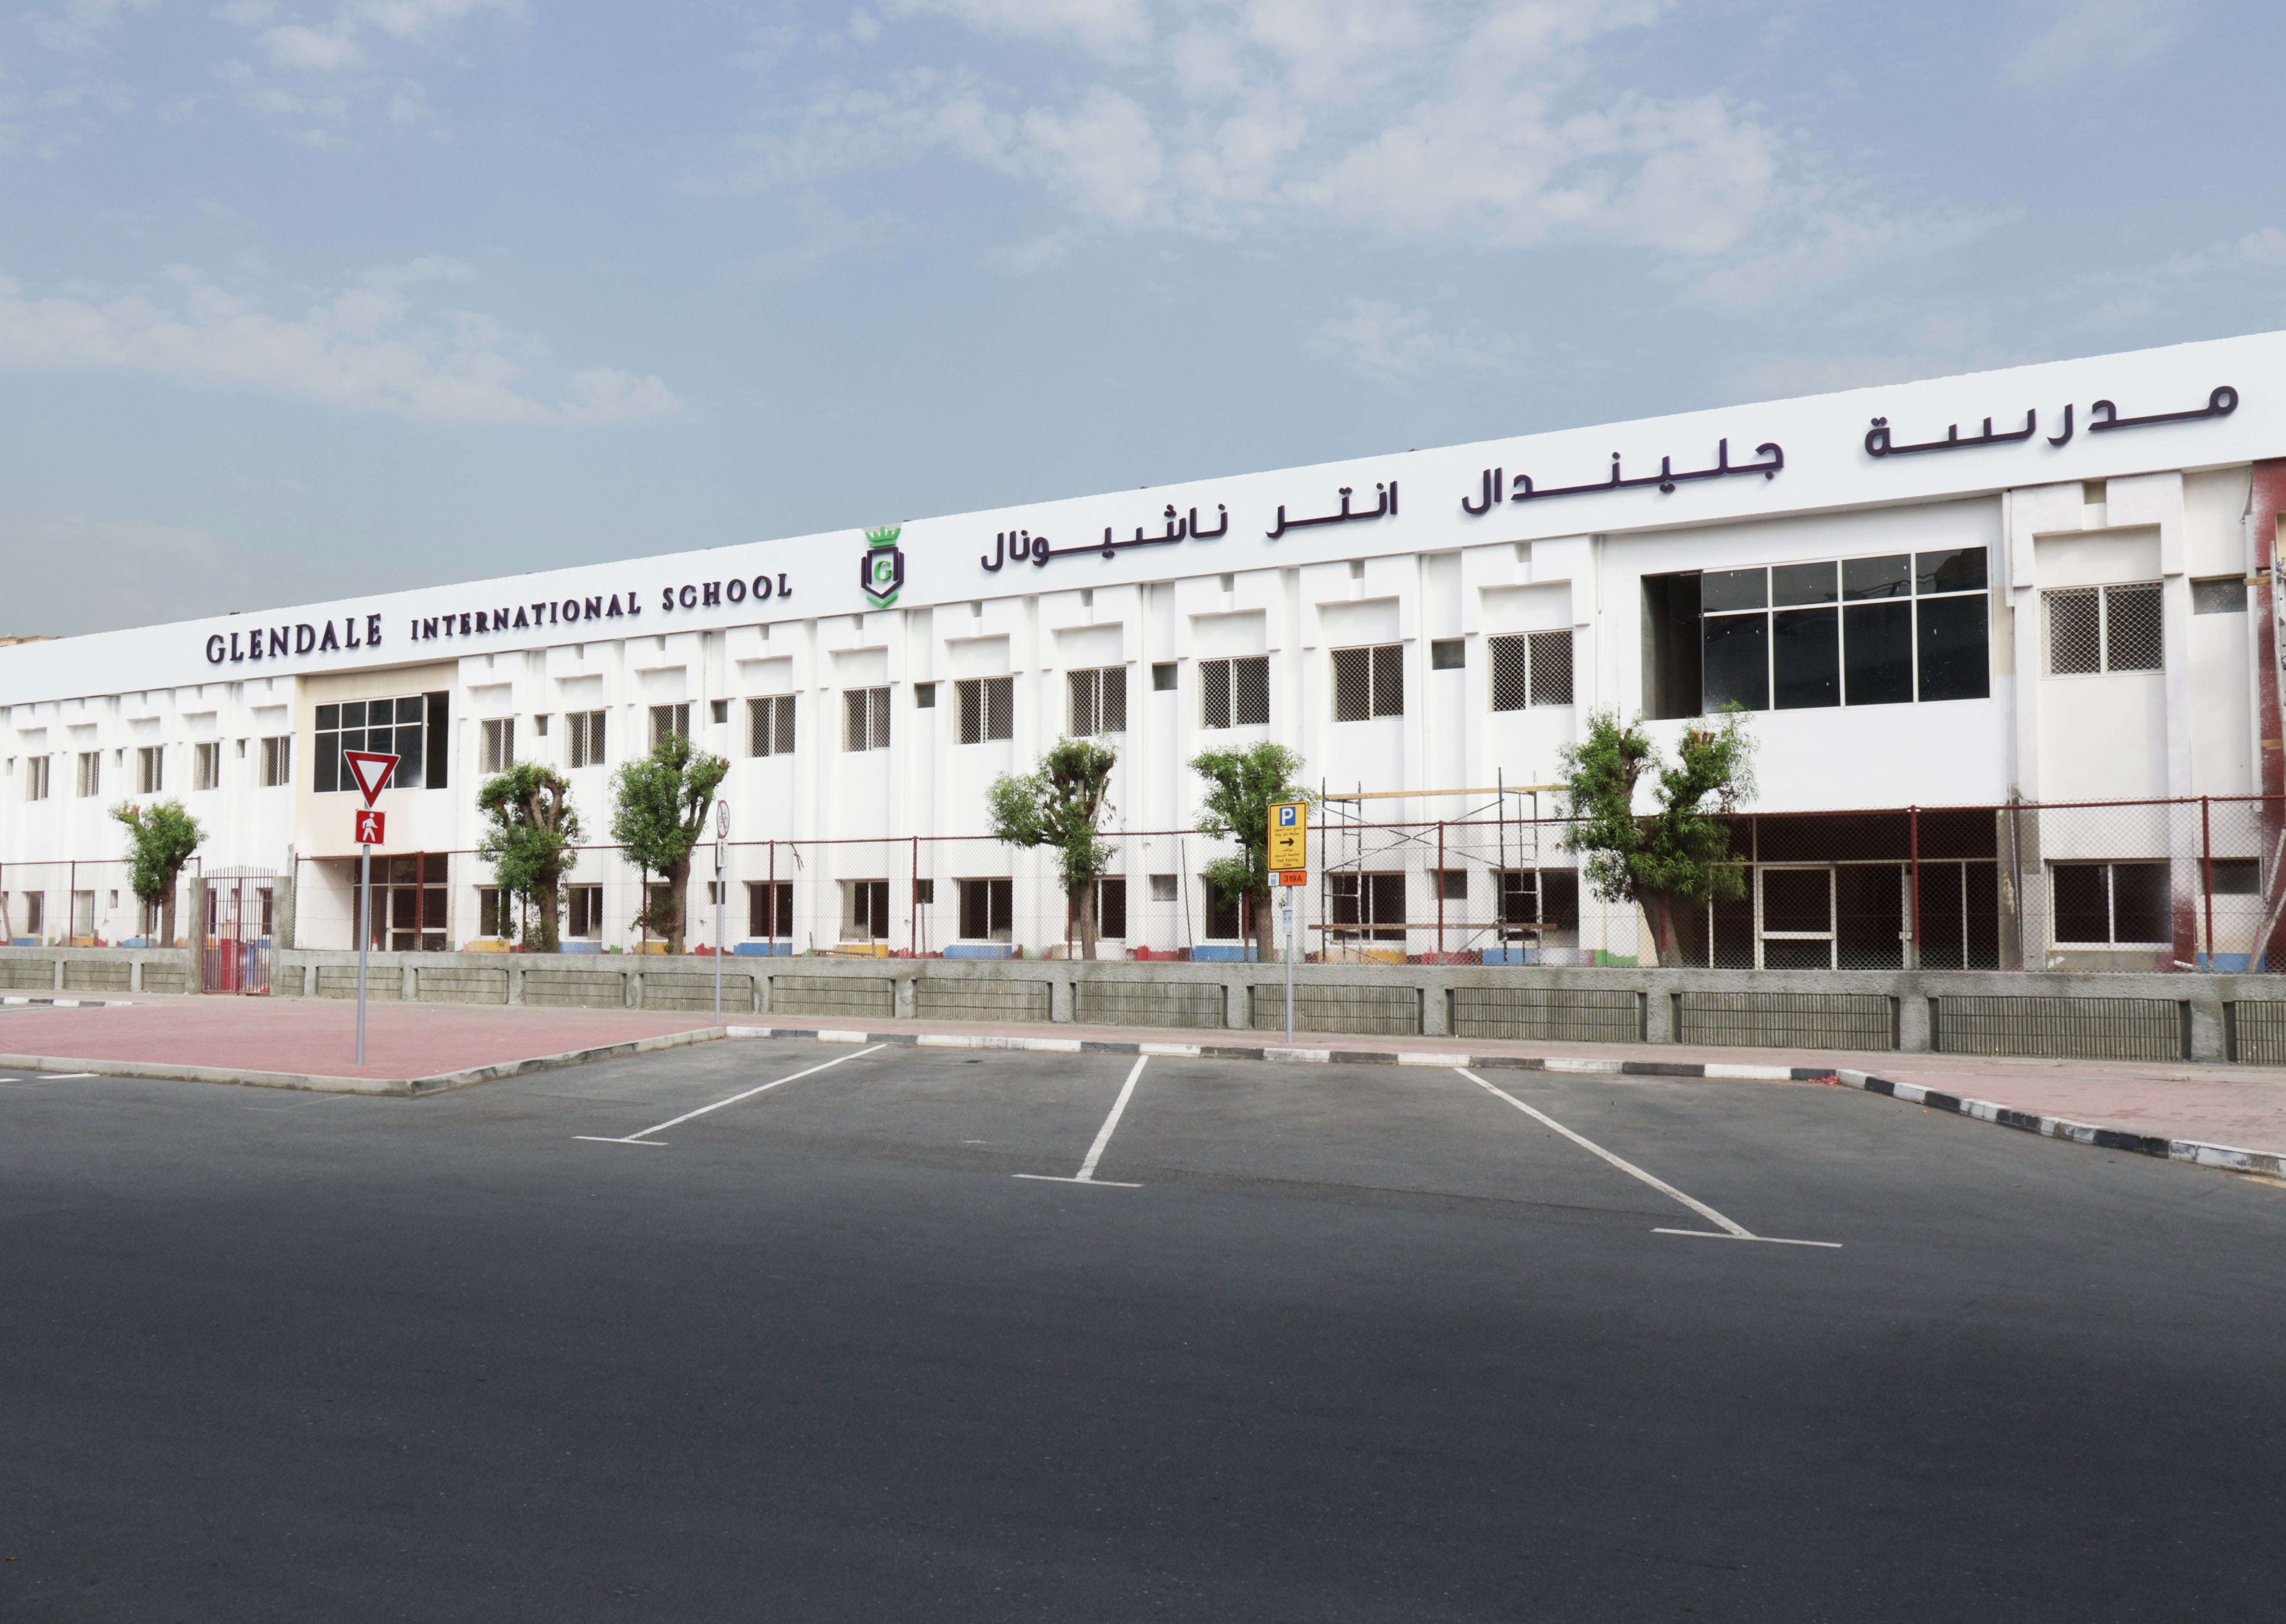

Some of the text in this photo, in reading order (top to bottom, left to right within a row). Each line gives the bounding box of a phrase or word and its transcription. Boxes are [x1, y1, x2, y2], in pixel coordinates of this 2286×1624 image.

[981, 386, 2239, 571] مدرسة جليندال انتر ناشيونال
[874, 560, 892, 581] G
[206, 573, 793, 664] GLENDALE INTERNATIONAL SCHOOL
[1282, 808, 1294, 825] P
